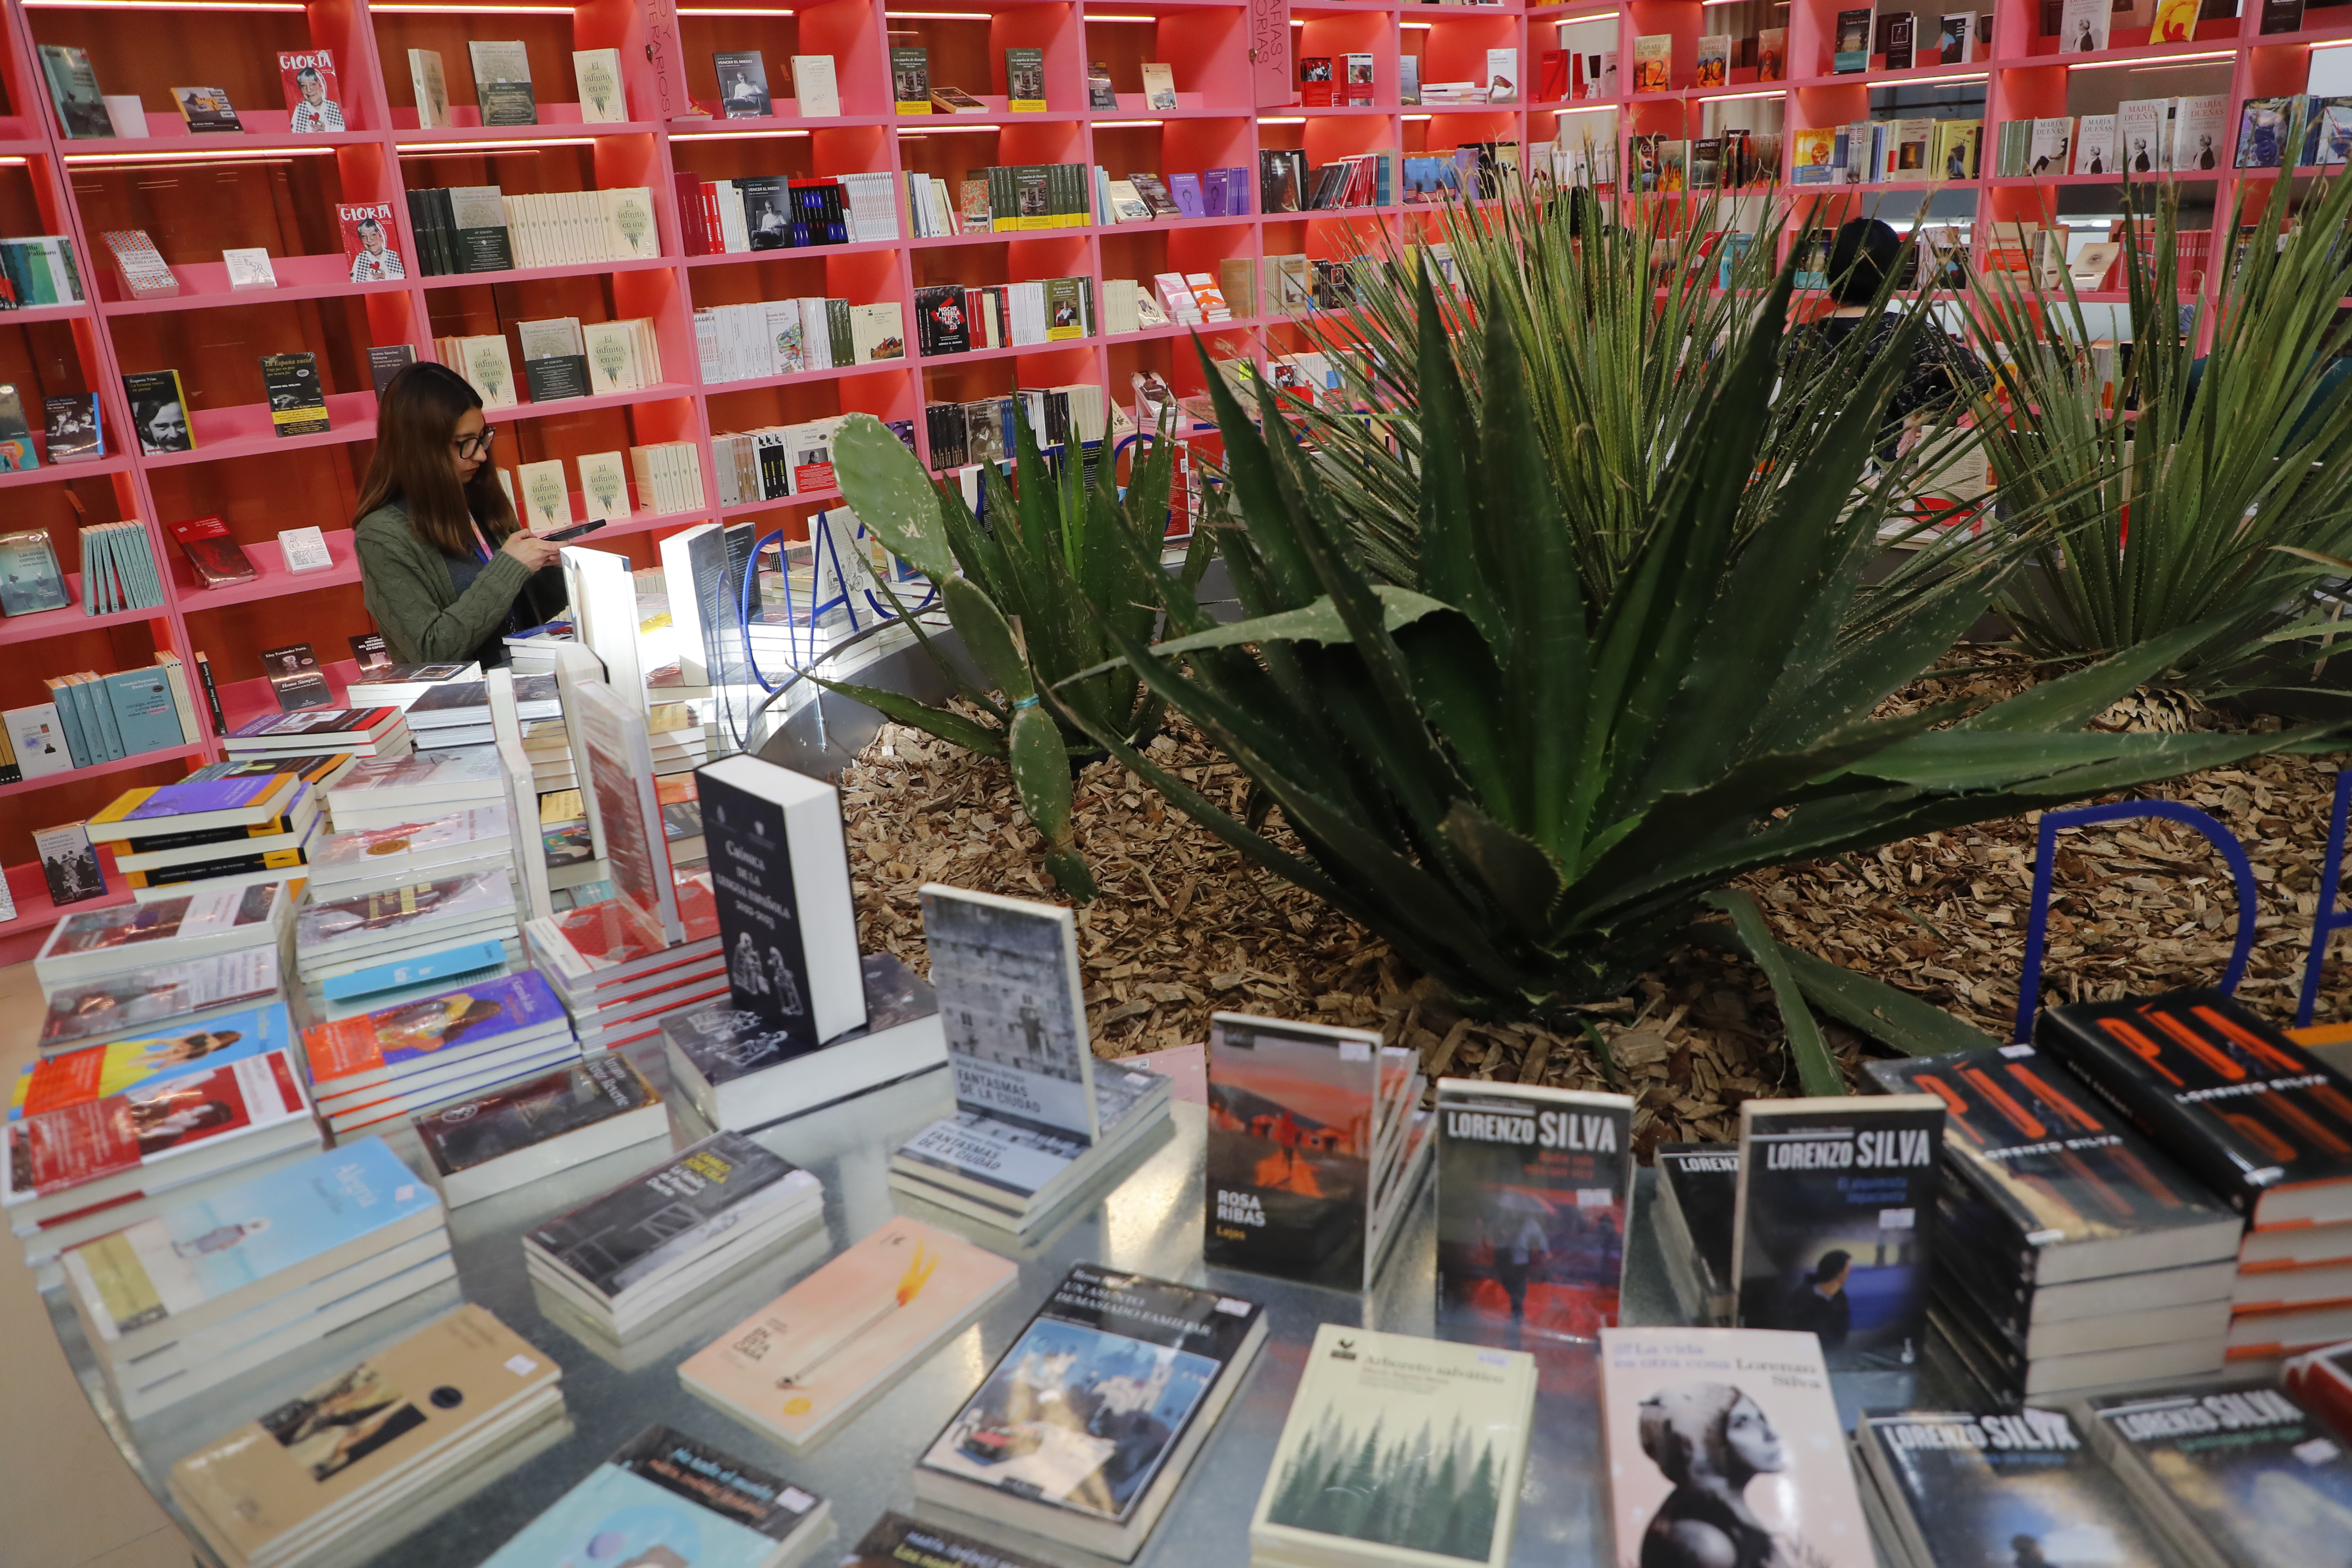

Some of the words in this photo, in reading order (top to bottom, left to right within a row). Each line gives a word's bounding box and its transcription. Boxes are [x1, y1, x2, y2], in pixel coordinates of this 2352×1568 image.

[280, 51, 331, 70] GLORIA
[1703, 57, 1723, 81] 10
[1640, 60, 1665, 86] 12
[590, 95, 610, 104] junco
[2195, 100, 2222, 109] MARÍA
[2124, 111, 2158, 122] DUEÑAS
[2128, 104, 2156, 113] MARÍA
[2190, 107, 2224, 117] DUEÑAS
[2037, 126, 2065, 135] DUEÑAS
[2040, 120, 2062, 128] MARÍA
[2084, 124, 2113, 133] DUEÑAS
[340, 205, 392, 221] GLORIA
[274, 358, 295, 367] España
[475, 359, 502, 368] infinito
[482, 379, 502, 389] junco
[591, 474, 617, 483] infinito
[597, 493, 617, 502] junco
[275, 648, 296, 657] Fernández
[298, 677, 318, 686] Sampler
[2095, 1002, 2304, 1087] PÚA
[957, 1069, 1029, 1097] FANTASMAS
[2174, 1081, 2268, 1105] LORENZO
[2269, 1073, 2328, 1091] SILVA
[960, 1082, 974, 1095] DE
[977, 1087, 992, 1099] LA
[996, 1092, 1041, 1113] CIUDAD
[1912, 1060, 2104, 1146] PÚA
[1447, 1111, 1537, 1145] LORENZO
[1538, 1109, 1617, 1154] SILVA
[927, 1130, 1001, 1160] FANTASMAS
[1767, 1141, 1855, 1170] LORENZO
[1856, 1129, 1931, 1167] SILVA
[1973, 1140, 2063, 1162] LORENZO
[2065, 1135, 2124, 1149] SILVA
[917, 1138, 935, 1148] DE
[936, 1145, 954, 1155] LA
[954, 1150, 1002, 1170] CIUDAD
[1217, 1189, 1262, 1211] ROSA
[1217, 1204, 1266, 1228] RIBAS
[1063, 1281, 1084, 1294] UN
[1086, 1286, 1146, 1307] ASUNTO
[1054, 1291, 1142, 1320] DEMASIADO
[1141, 1310, 1212, 1337] FAMILIAR
[1635, 1343, 1658, 1354] La
[1663, 1343, 1705, 1355] vida
[1364, 1355, 1433, 1373] Arboreto
[1639, 1359, 1681, 1368] otra
[1684, 1360, 1731, 1369] cosa
[1735, 1357, 1817, 1374] Lorenzo
[1771, 1375, 1821, 1390] Silva
[2115, 1406, 2218, 1442] LORENZO
[2201, 1388, 2304, 1428] SILVA
[1883, 1424, 1988, 1450] LORENZO
[1980, 1415, 2081, 1451] SILVA
